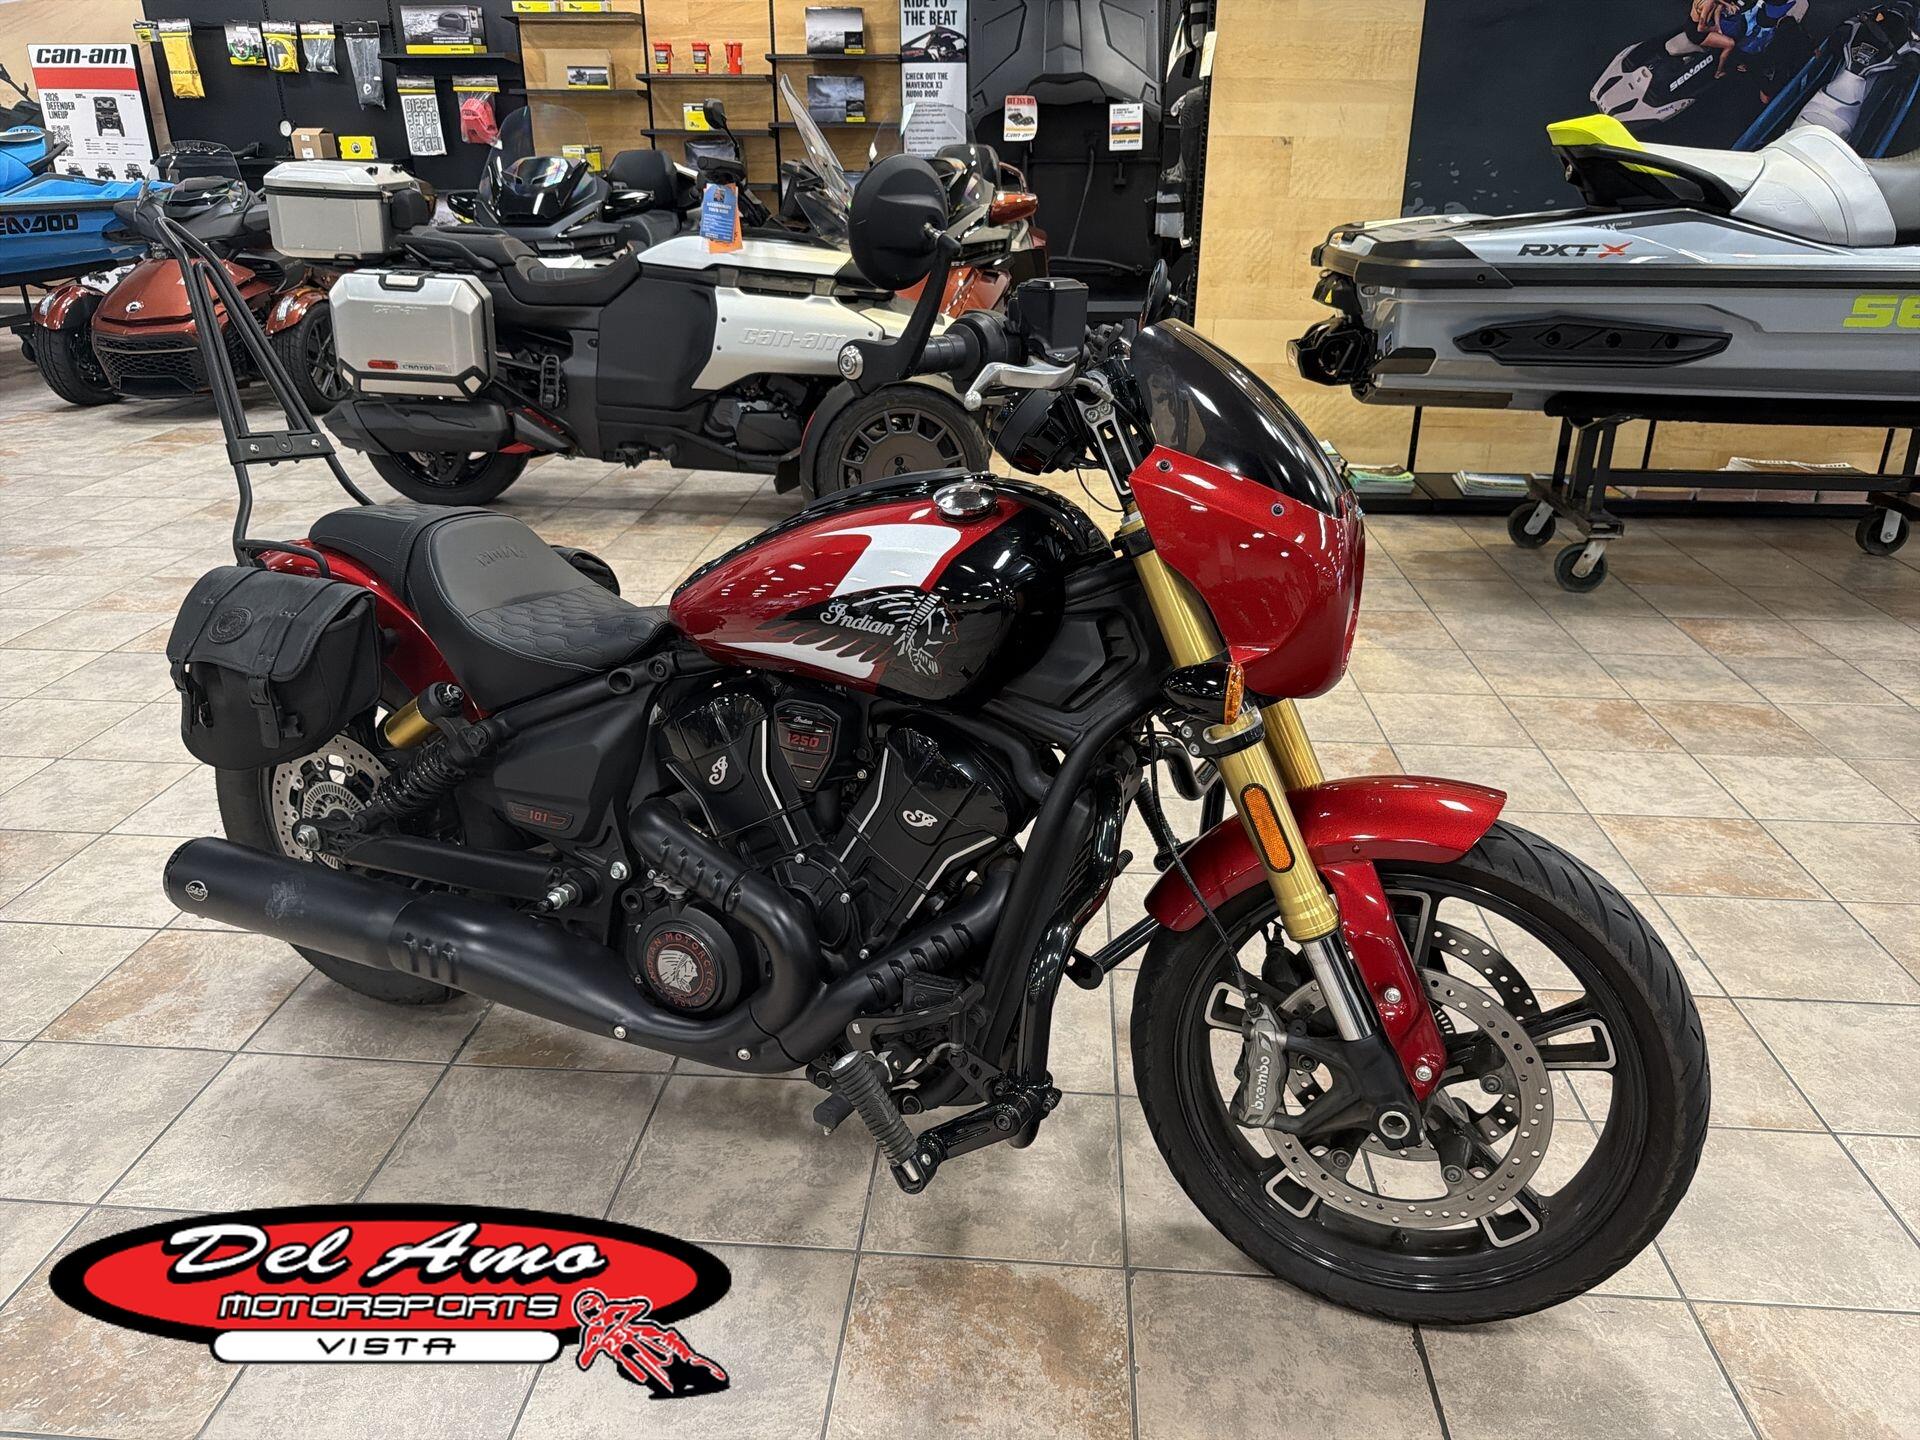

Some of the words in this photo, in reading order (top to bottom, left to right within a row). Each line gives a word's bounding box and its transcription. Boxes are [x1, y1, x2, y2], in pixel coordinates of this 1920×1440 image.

[904, 10, 925, 26] THE
[930, 10, 957, 26] BEAT
[36, 48, 128, 64] can-am
[905, 72, 924, 80] CHECK
[925, 72, 936, 80] OUT
[937, 72, 948, 80] THE
[905, 81, 934, 89] MAVERICK
[44, 92, 60, 101] 2026
[905, 90, 923, 98] AUDIO
[924, 90, 939, 98] ROOF
[46, 101, 76, 111] DEFENDER
[48, 110, 69, 119] LINEUP
[819, 603, 896, 636] Indian
[787, 732, 820, 748] 1250
[529, 809, 549, 823] 101
[187, 885, 205, 897] S&S
[665, 932, 714, 1000] MOTORCYCLE
[1250, 1055, 1271, 1111] brembo
